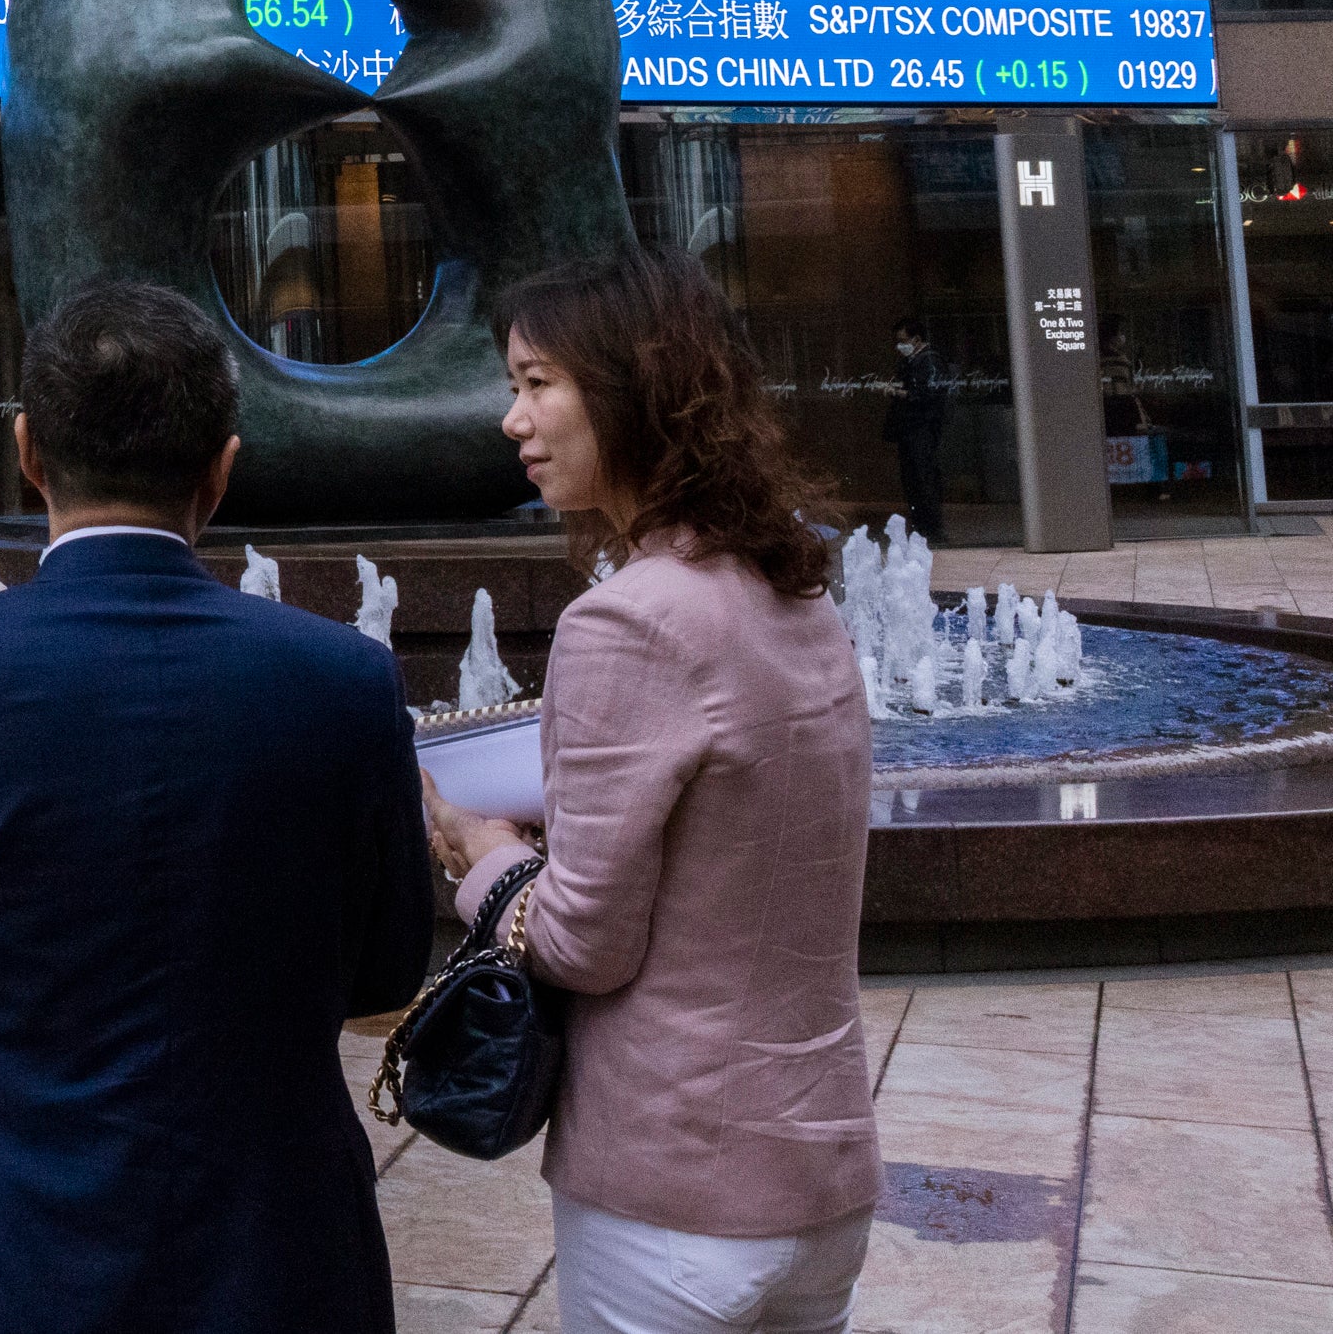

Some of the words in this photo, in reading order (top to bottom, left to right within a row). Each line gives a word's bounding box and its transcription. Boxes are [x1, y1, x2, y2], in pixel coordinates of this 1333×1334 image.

[810, 5, 935, 35] S&P/TSX
[942, 7, 1113, 36] COMPOSITE
[623, 57, 708, 86] ANDS
[717, 57, 811, 86] CHINA
[819, 59, 873, 86] LTD
[891, 59, 964, 88] 26.45
[1119, 61, 1196, 89] 01929
[1039, 318, 1057, 328] One
[1058, 317, 1066, 328] &
[1066, 317, 1084, 328] Two
[1045, 329, 1085, 341] Exchange
[1056, 340, 1086, 352] Square
